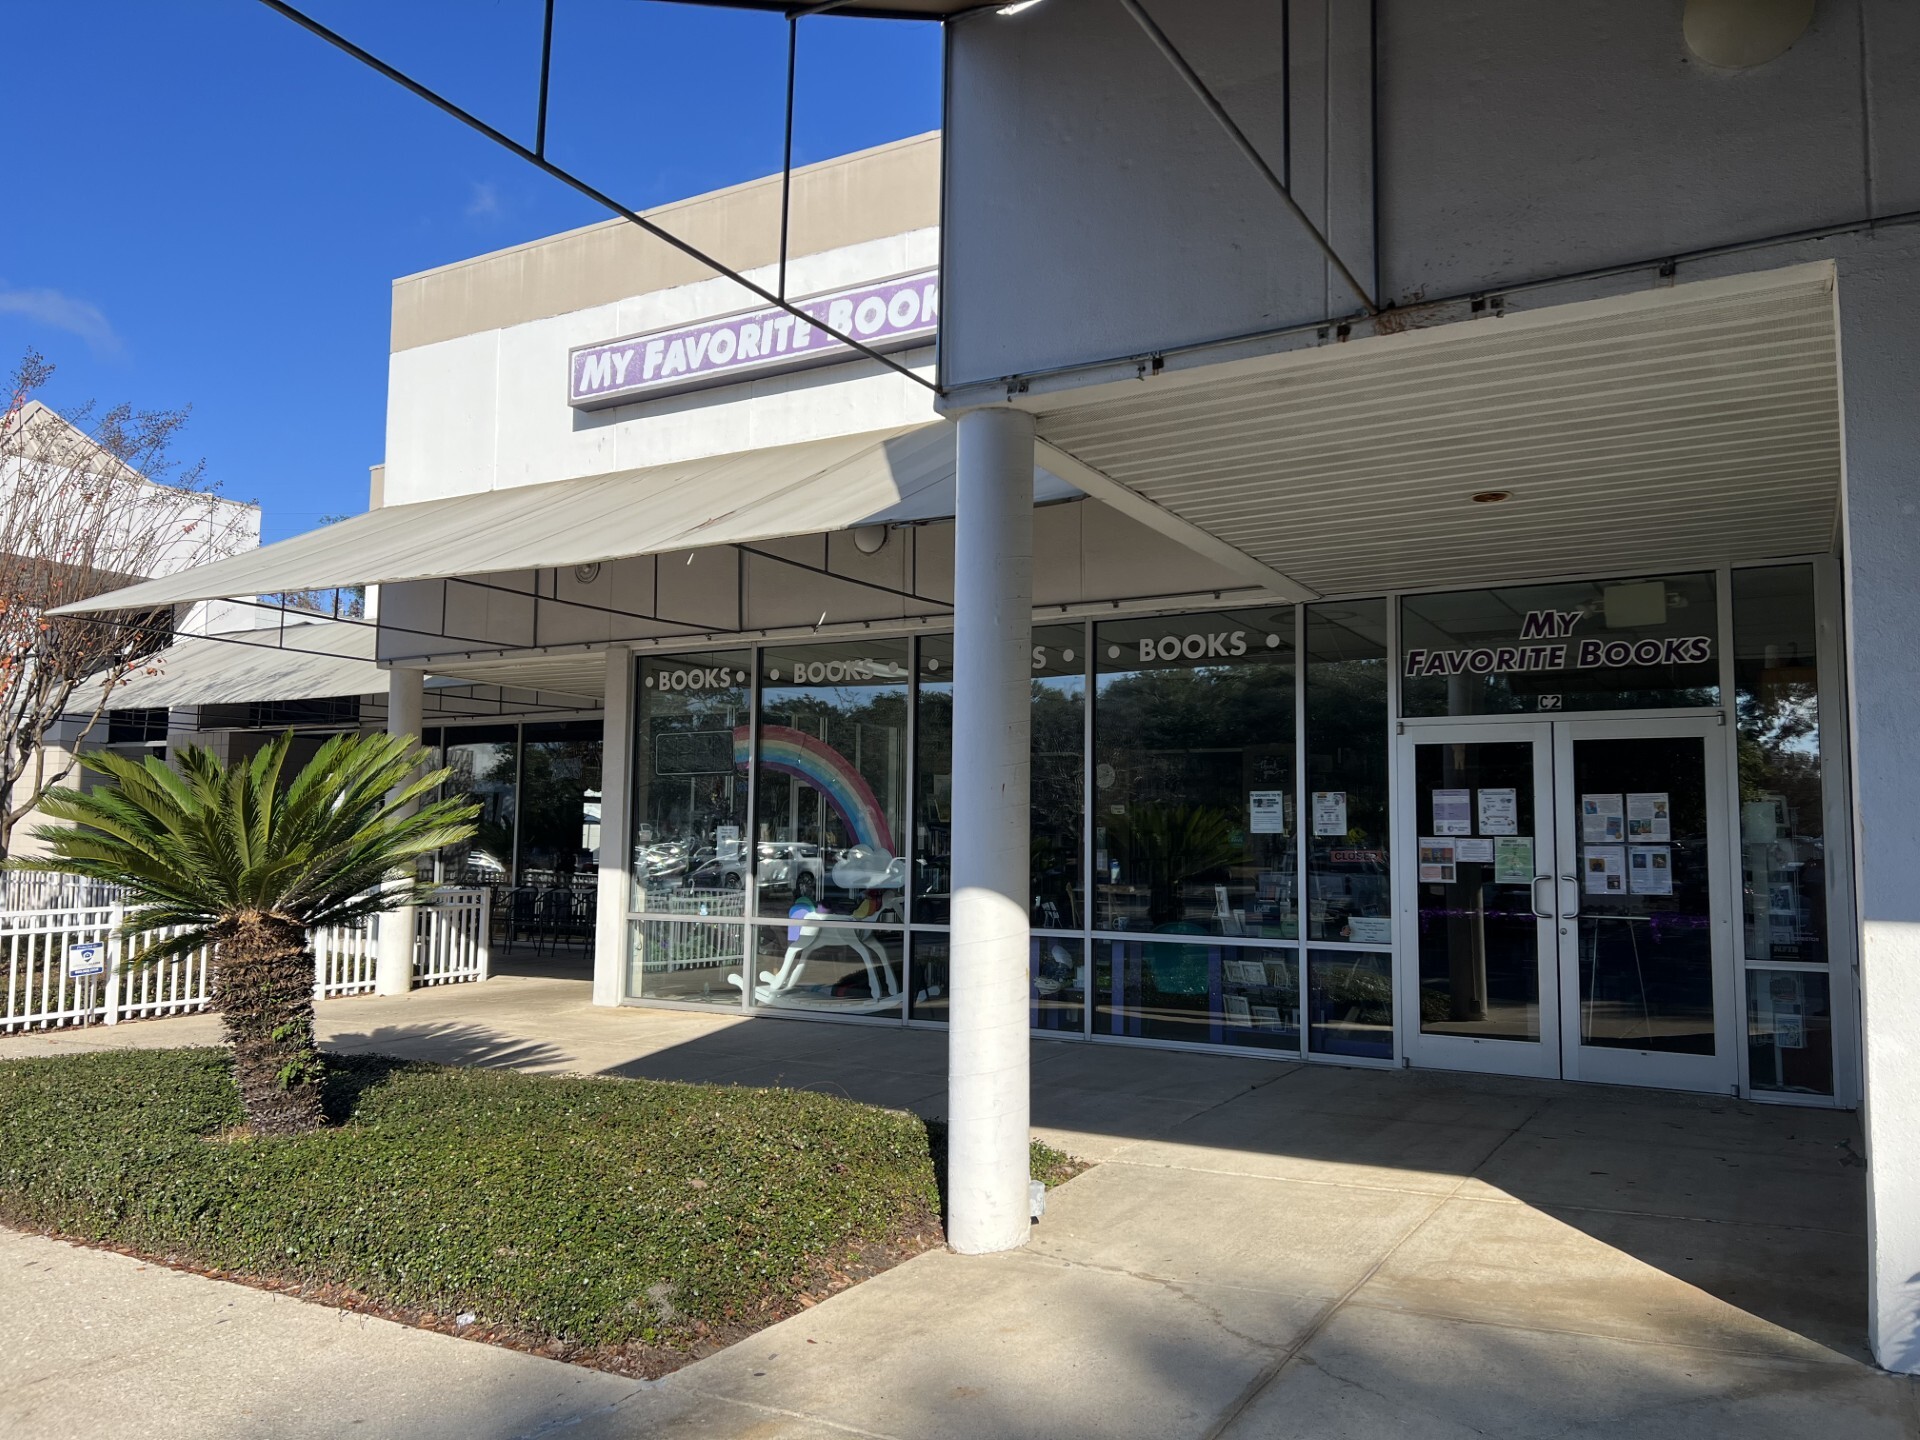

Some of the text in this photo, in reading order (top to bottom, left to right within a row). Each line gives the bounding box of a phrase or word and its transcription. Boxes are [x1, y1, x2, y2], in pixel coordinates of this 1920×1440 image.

[579, 283, 939, 392] MY FAVORITE BOOK
[1519, 609, 1584, 640] MY
[1138, 630, 1247, 662] BOOKS
[1405, 636, 1711, 677] FAVORITE BOOKS
[658, 667, 731, 691] BOOKS
[793, 658, 875, 684] BOOKS
[1539, 695, 1562, 710] C2
